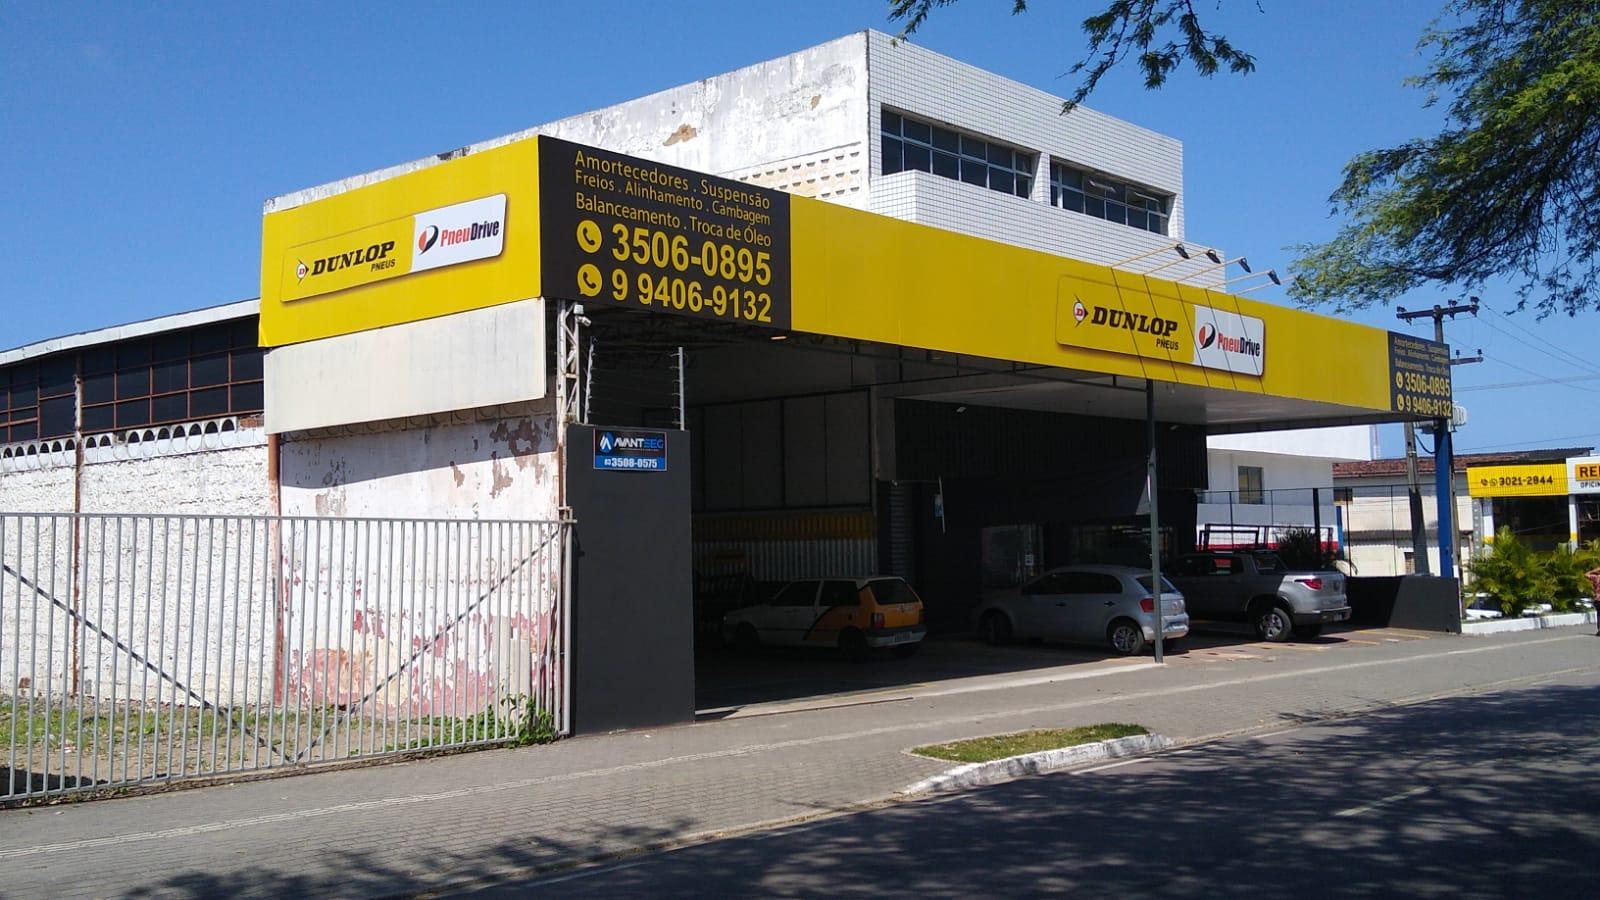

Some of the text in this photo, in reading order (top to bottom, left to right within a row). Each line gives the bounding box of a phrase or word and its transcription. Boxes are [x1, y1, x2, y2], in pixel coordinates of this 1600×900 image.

[575, 150, 770, 210] Amortecedores Suspensão
[575, 169, 770, 226] Freios Alinhamento Cambagem
[440, 220, 500, 248] PneuDrive
[576, 192, 771, 247] Balanceamento Troca de Óleo
[311, 240, 395, 276] DUNLOP
[370, 258, 396, 273] PNEUS
[611, 223, 772, 286] 3506-0895
[611, 268, 772, 323] 9 9406-9132
[1091, 306, 1178, 337] DUNLOP
[1156, 338, 1179, 351] PNEUS
[1217, 332, 1261, 357] PneuDrive
[1405, 372, 1450, 397] 3506-0895
[1413, 396, 1452, 417] 9406-9132
[1579, 465, 1600, 478] RE
